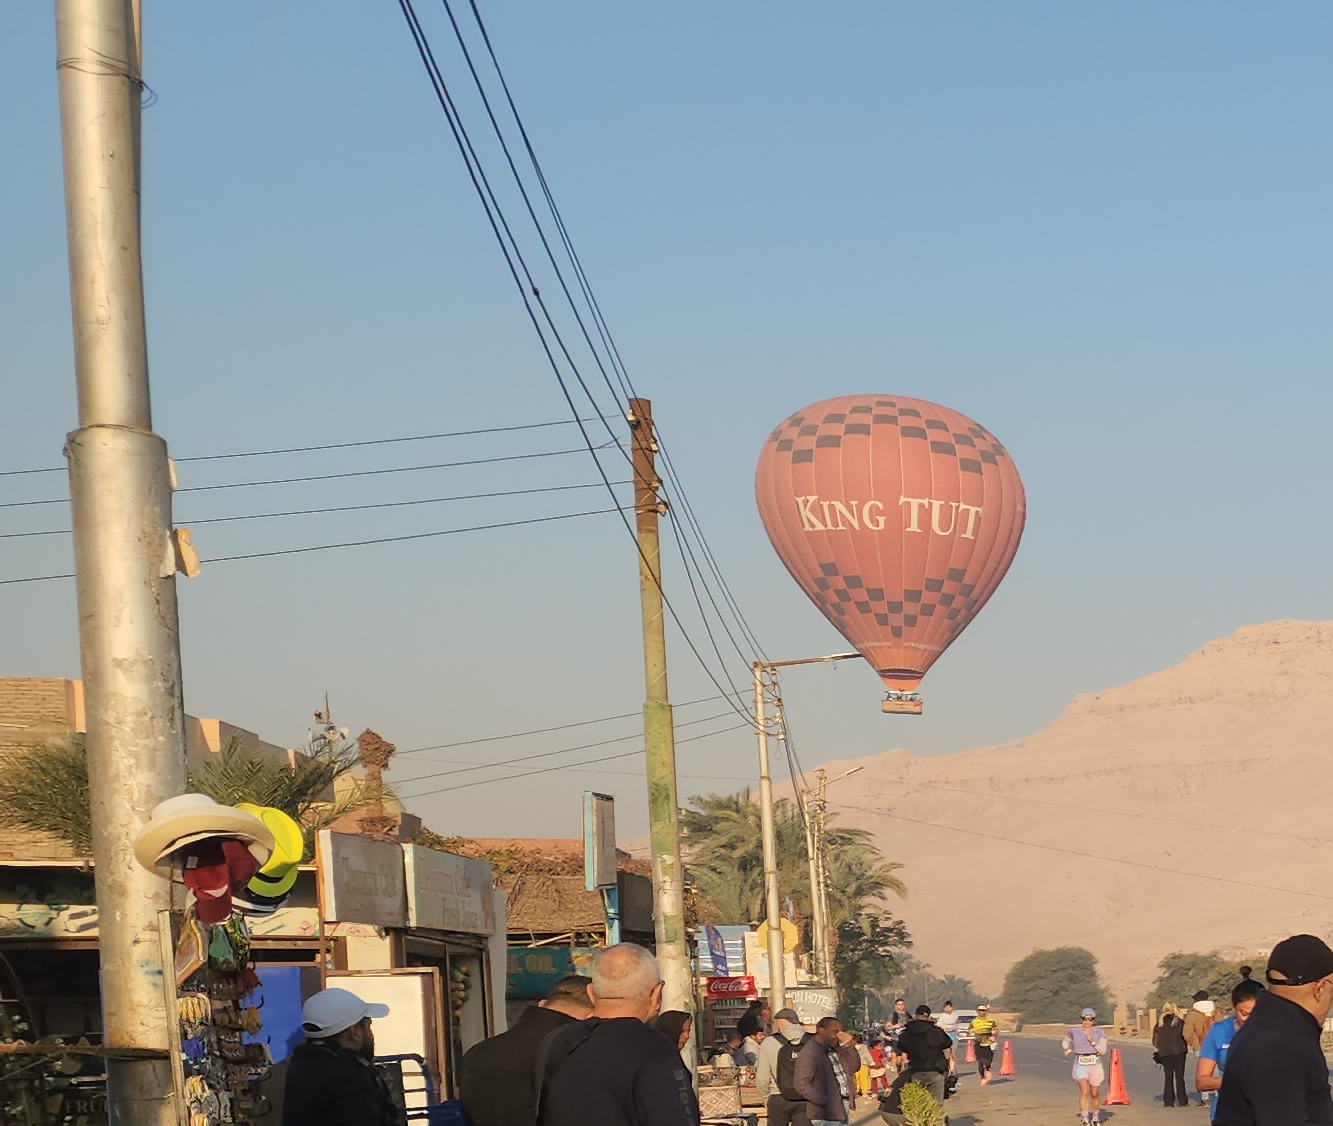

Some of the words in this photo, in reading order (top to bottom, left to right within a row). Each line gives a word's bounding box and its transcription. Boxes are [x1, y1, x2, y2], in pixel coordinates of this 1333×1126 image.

[795, 495, 886, 532] KING
[898, 495, 983, 540] TUT
[804, 991, 832, 1010] HOTEL
